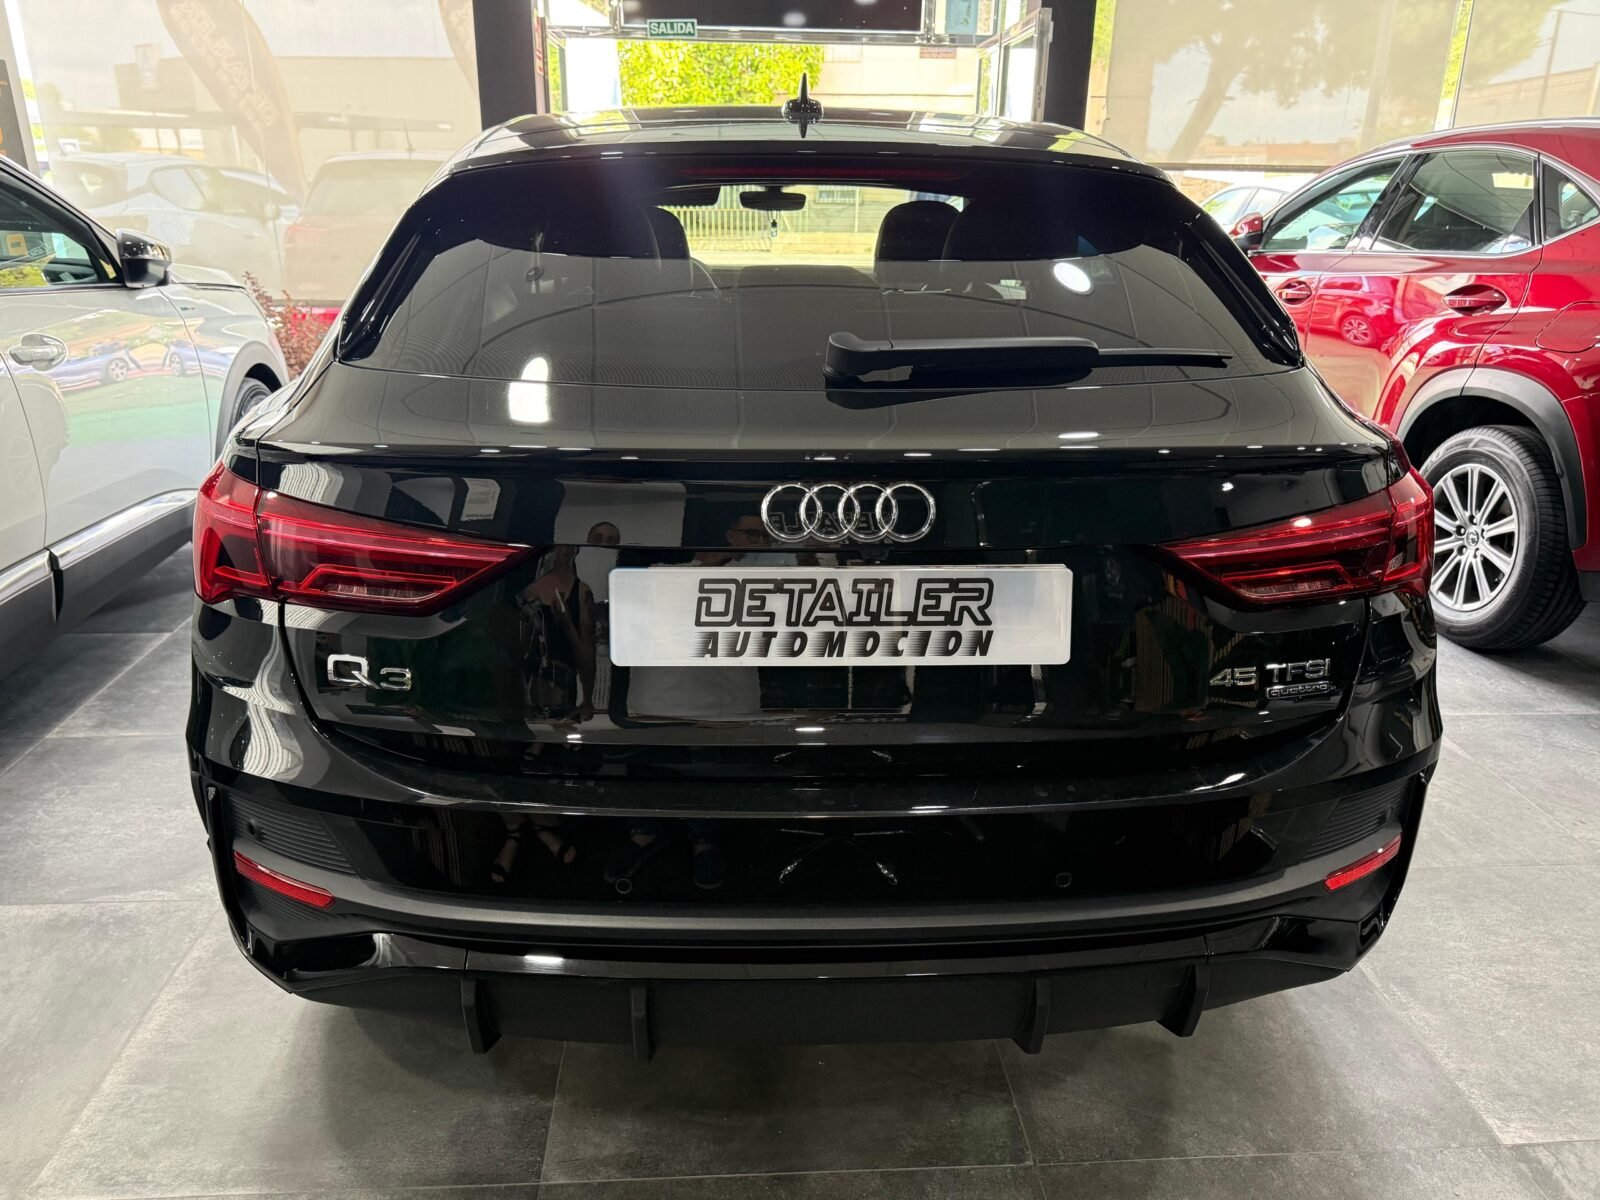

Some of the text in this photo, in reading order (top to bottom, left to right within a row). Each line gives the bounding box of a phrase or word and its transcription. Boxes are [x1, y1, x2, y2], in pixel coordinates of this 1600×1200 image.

[650, 23, 694, 34] SALIDA
[695, 578, 994, 627] DETAILER
[690, 630, 994, 658] AUTOMOCION
[327, 653, 412, 690] Q3
[1209, 658, 1331, 687] 45 TFSI
[1269, 683, 1329, 698] quattro
